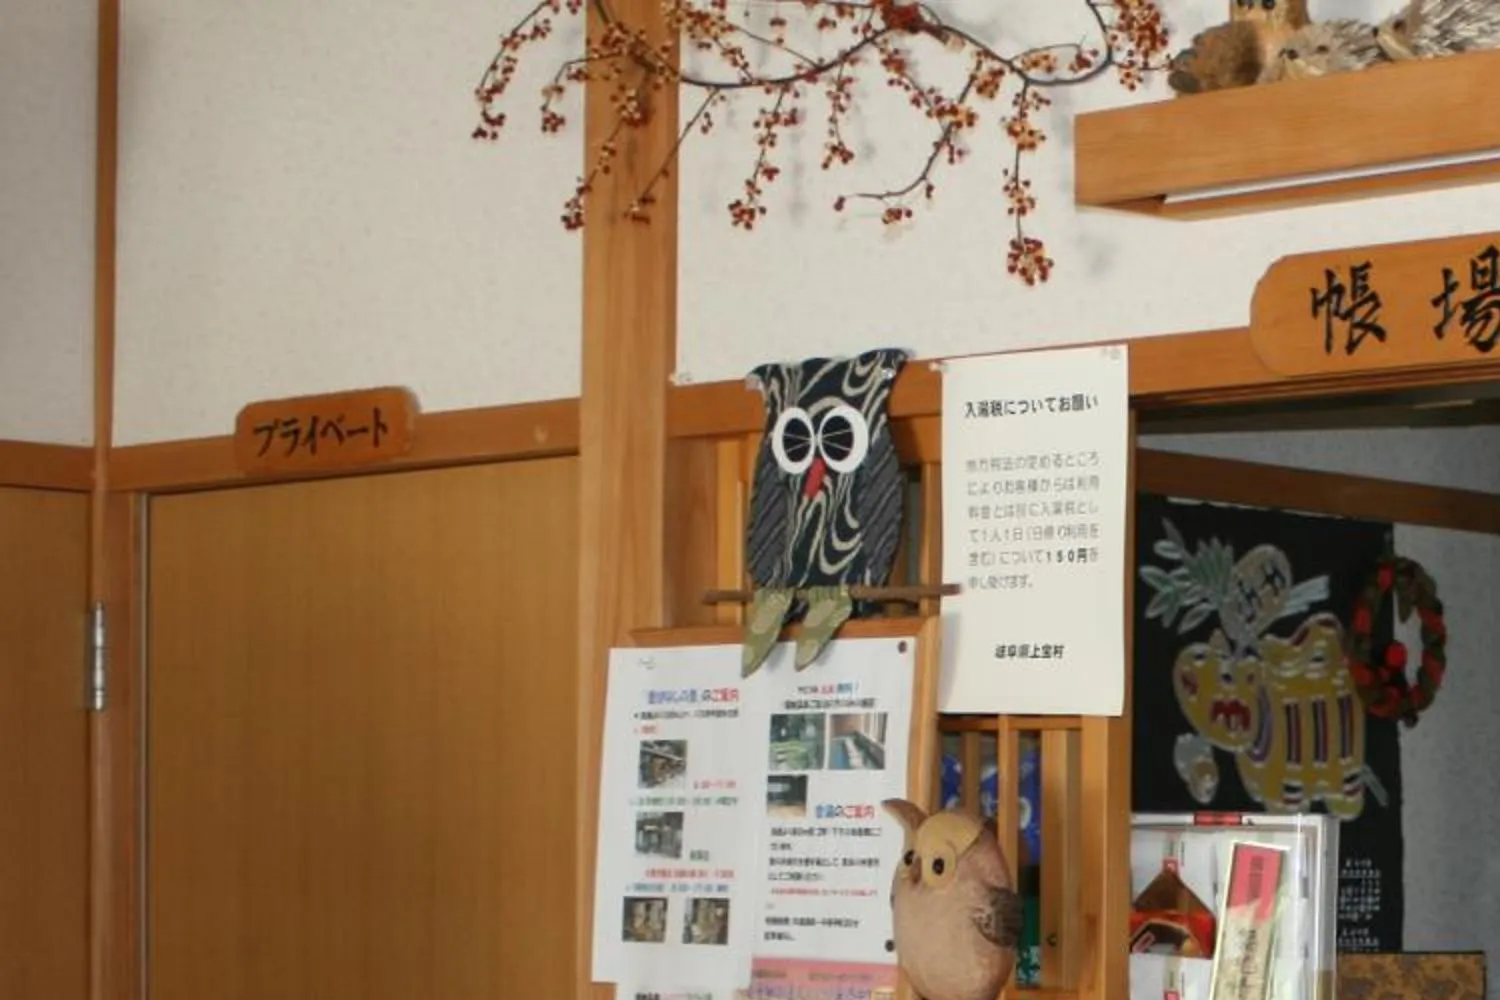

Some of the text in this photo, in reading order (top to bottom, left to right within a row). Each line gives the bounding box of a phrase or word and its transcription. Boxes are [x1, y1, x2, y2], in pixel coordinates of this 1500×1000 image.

[965, 394, 1099, 419] 入湯税についてお願い
[253, 407, 388, 457] プライベート
